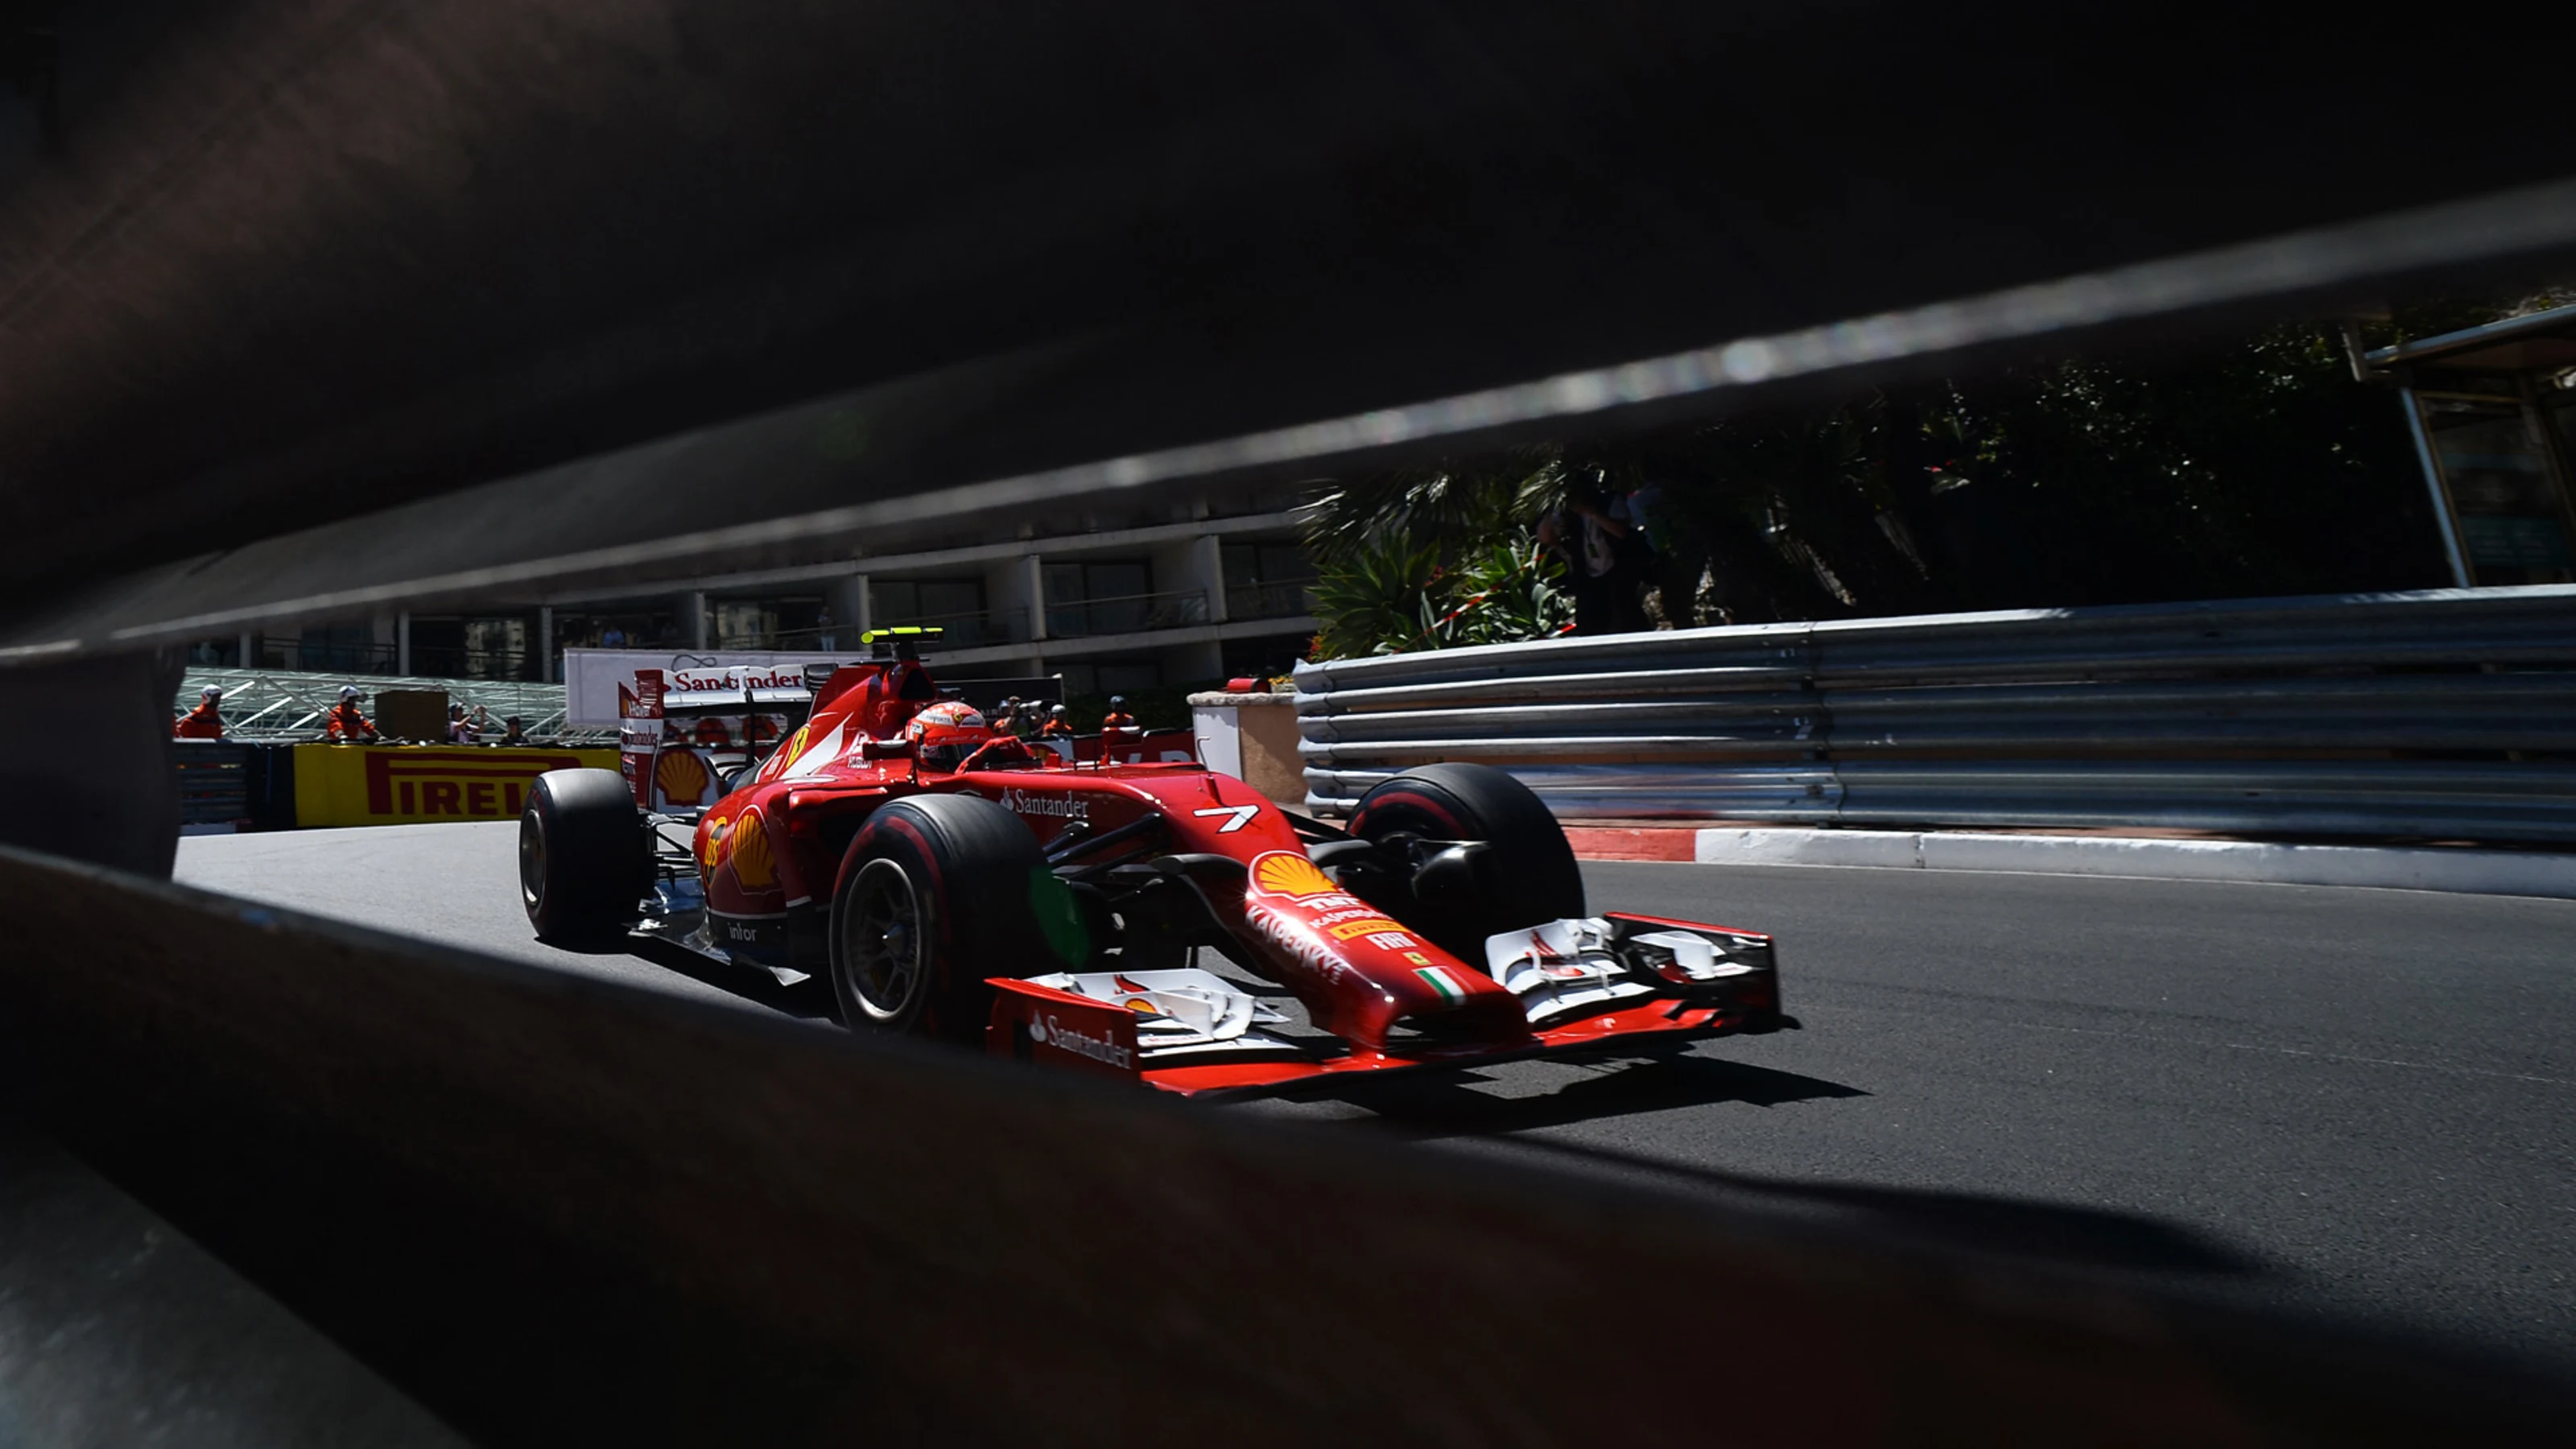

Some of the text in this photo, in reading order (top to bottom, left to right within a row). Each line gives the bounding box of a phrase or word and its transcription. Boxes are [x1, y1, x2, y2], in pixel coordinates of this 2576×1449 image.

[365, 752, 582, 815] PIREL
[1015, 788, 1089, 818] Santander
[1193, 803, 1260, 832] 7
[727, 921, 757, 941] infor
[1365, 931, 1418, 951] FIAT
[1047, 1014, 1133, 1071] Santander
